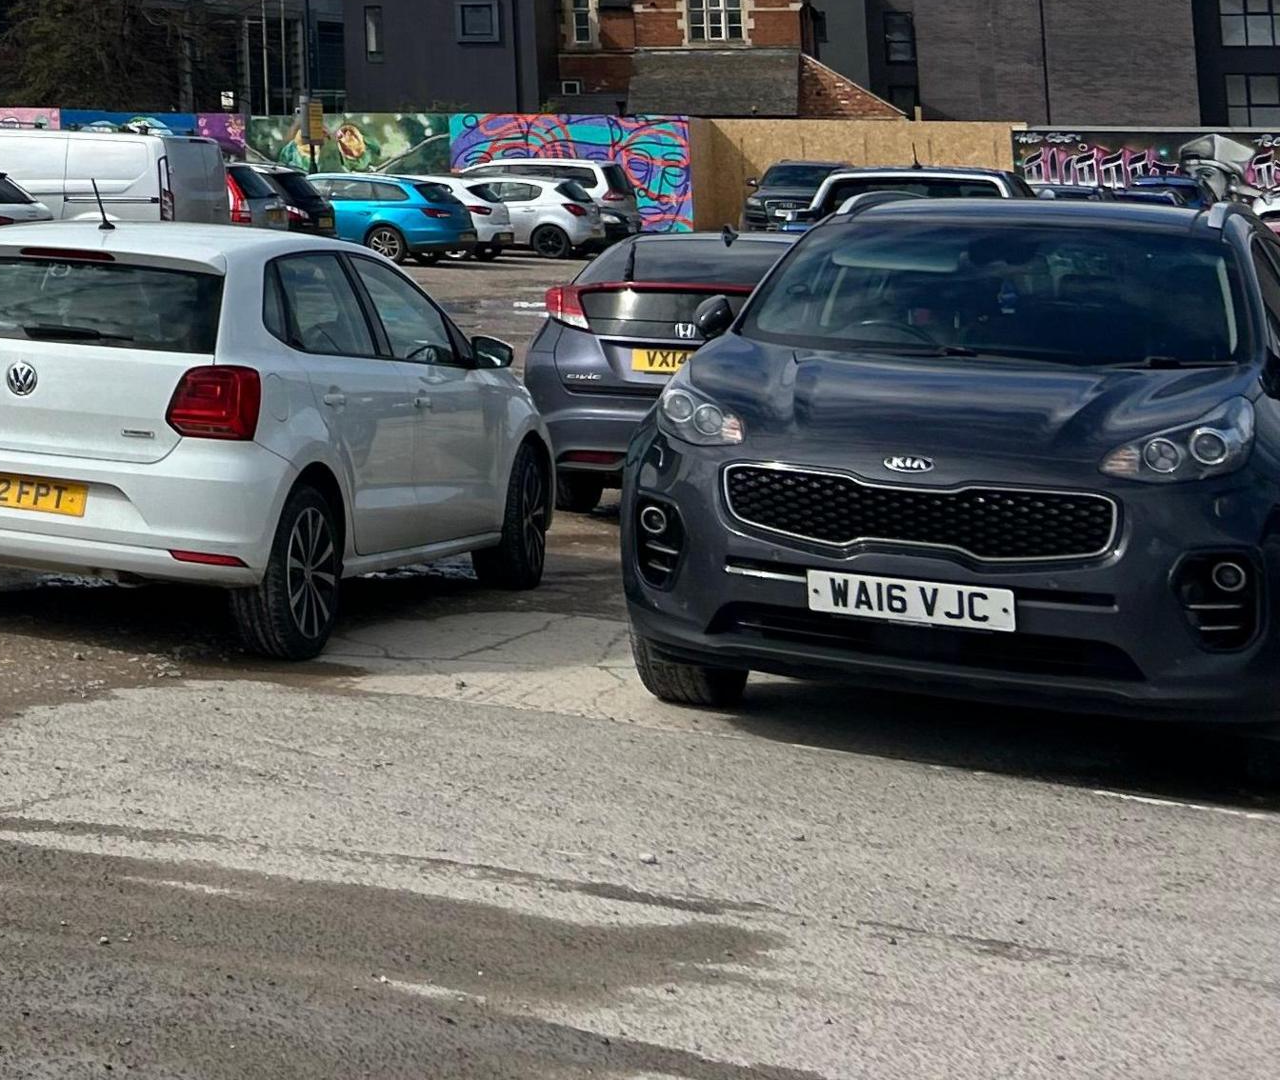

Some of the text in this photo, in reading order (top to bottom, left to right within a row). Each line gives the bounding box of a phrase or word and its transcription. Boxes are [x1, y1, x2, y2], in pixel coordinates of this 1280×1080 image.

[890, 456, 926, 470] KIA
[15, 481, 68, 510] FPT
[829, 577, 989, 623] WA16 VJC
